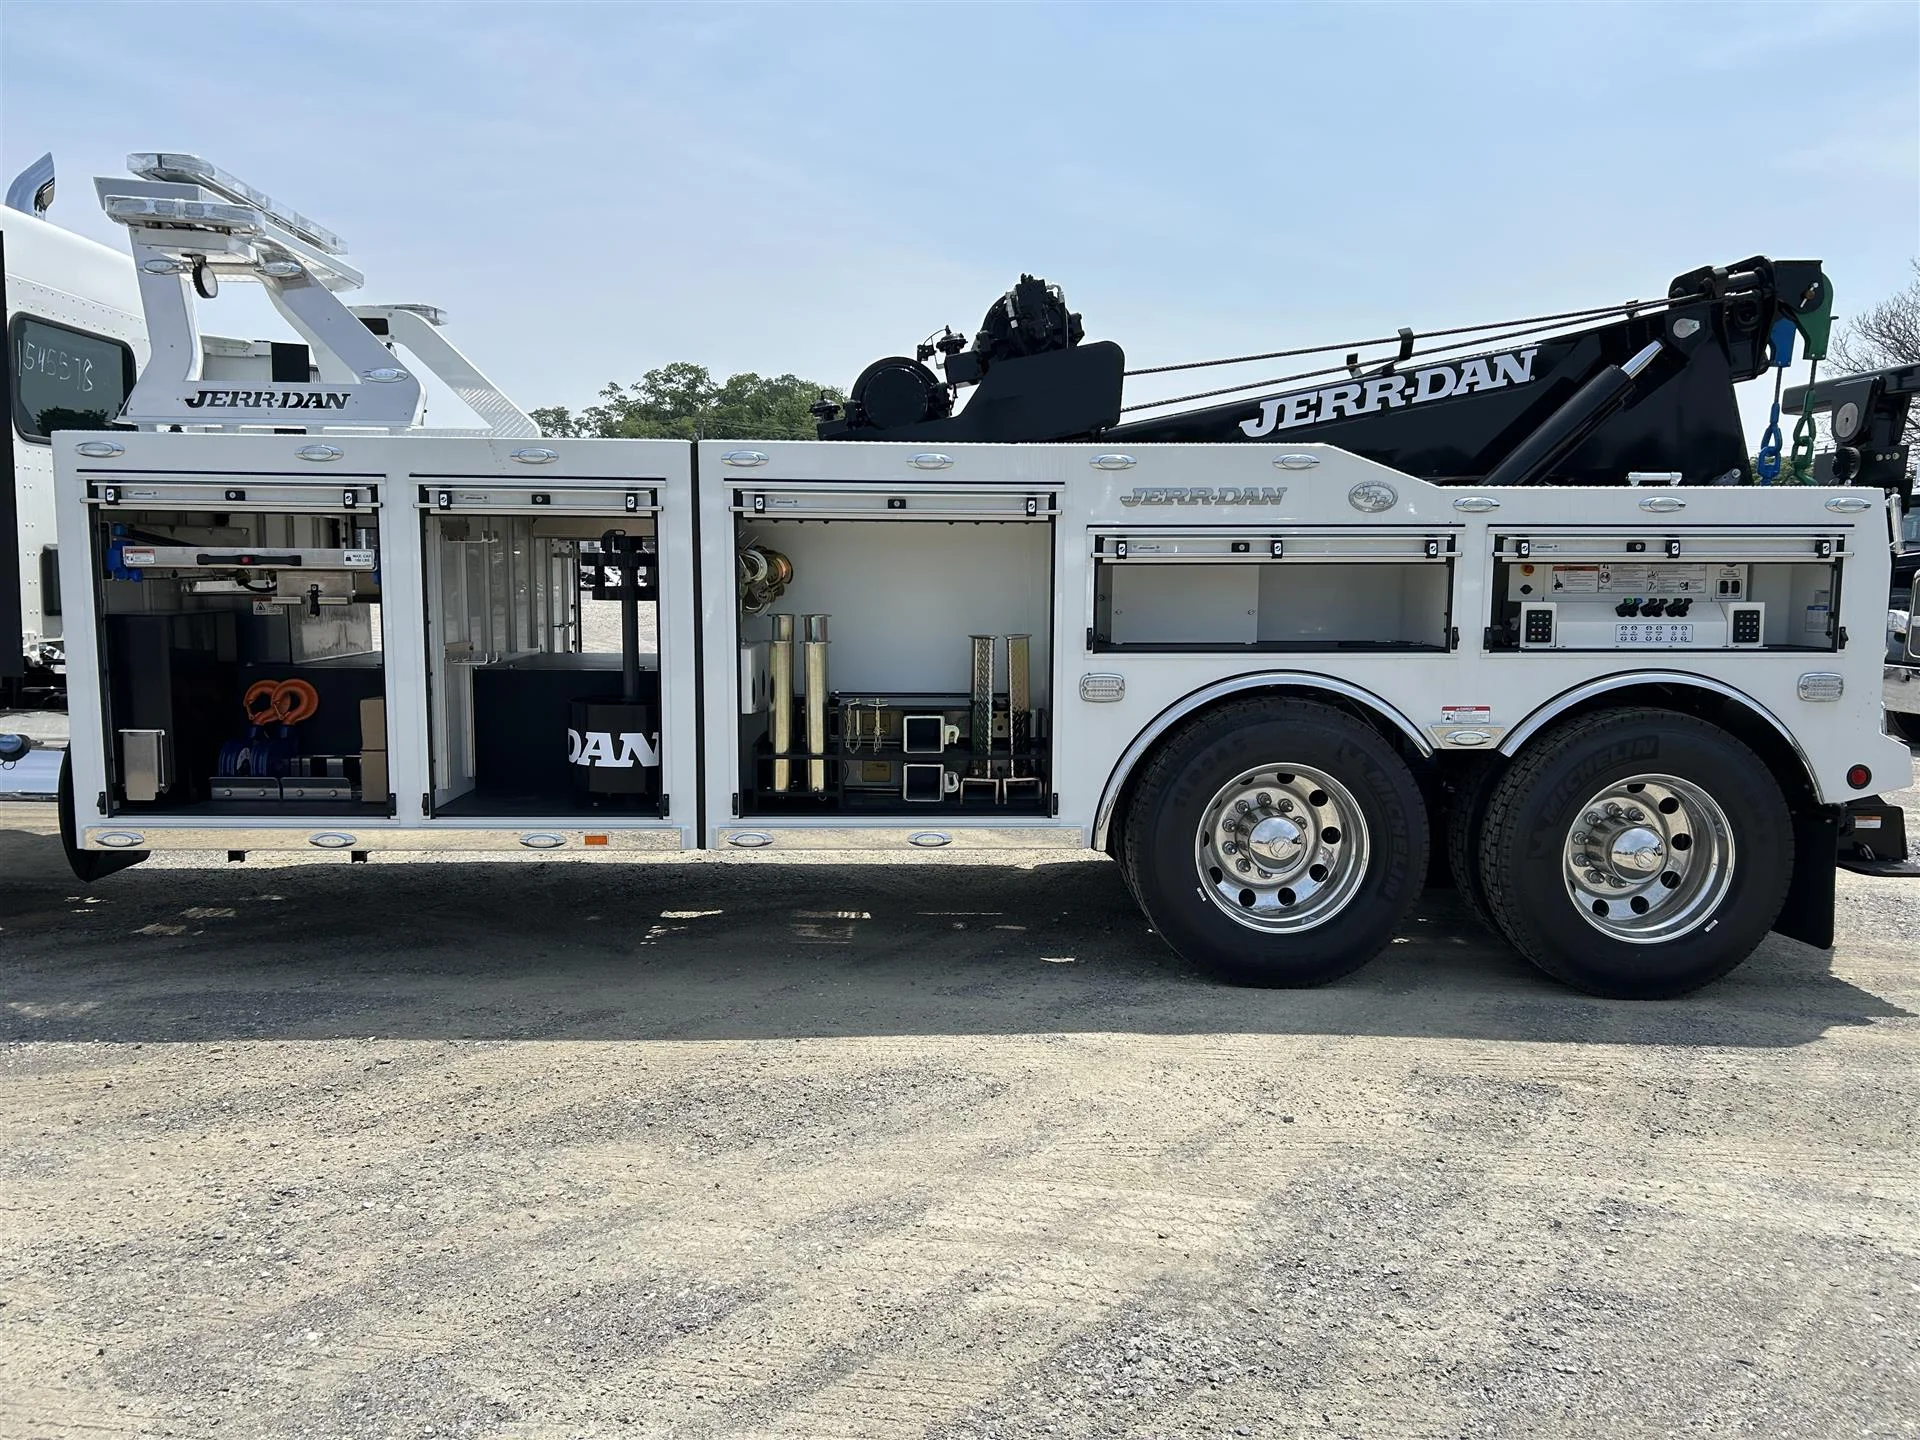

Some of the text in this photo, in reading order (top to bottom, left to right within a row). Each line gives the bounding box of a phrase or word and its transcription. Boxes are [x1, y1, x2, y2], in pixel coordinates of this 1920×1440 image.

[184, 389, 352, 409] JERR-DAN
[1239, 348, 1539, 438] JERR-DAN
[1119, 486, 1288, 508] JERR-DAN
[567, 727, 660, 768] DAN
